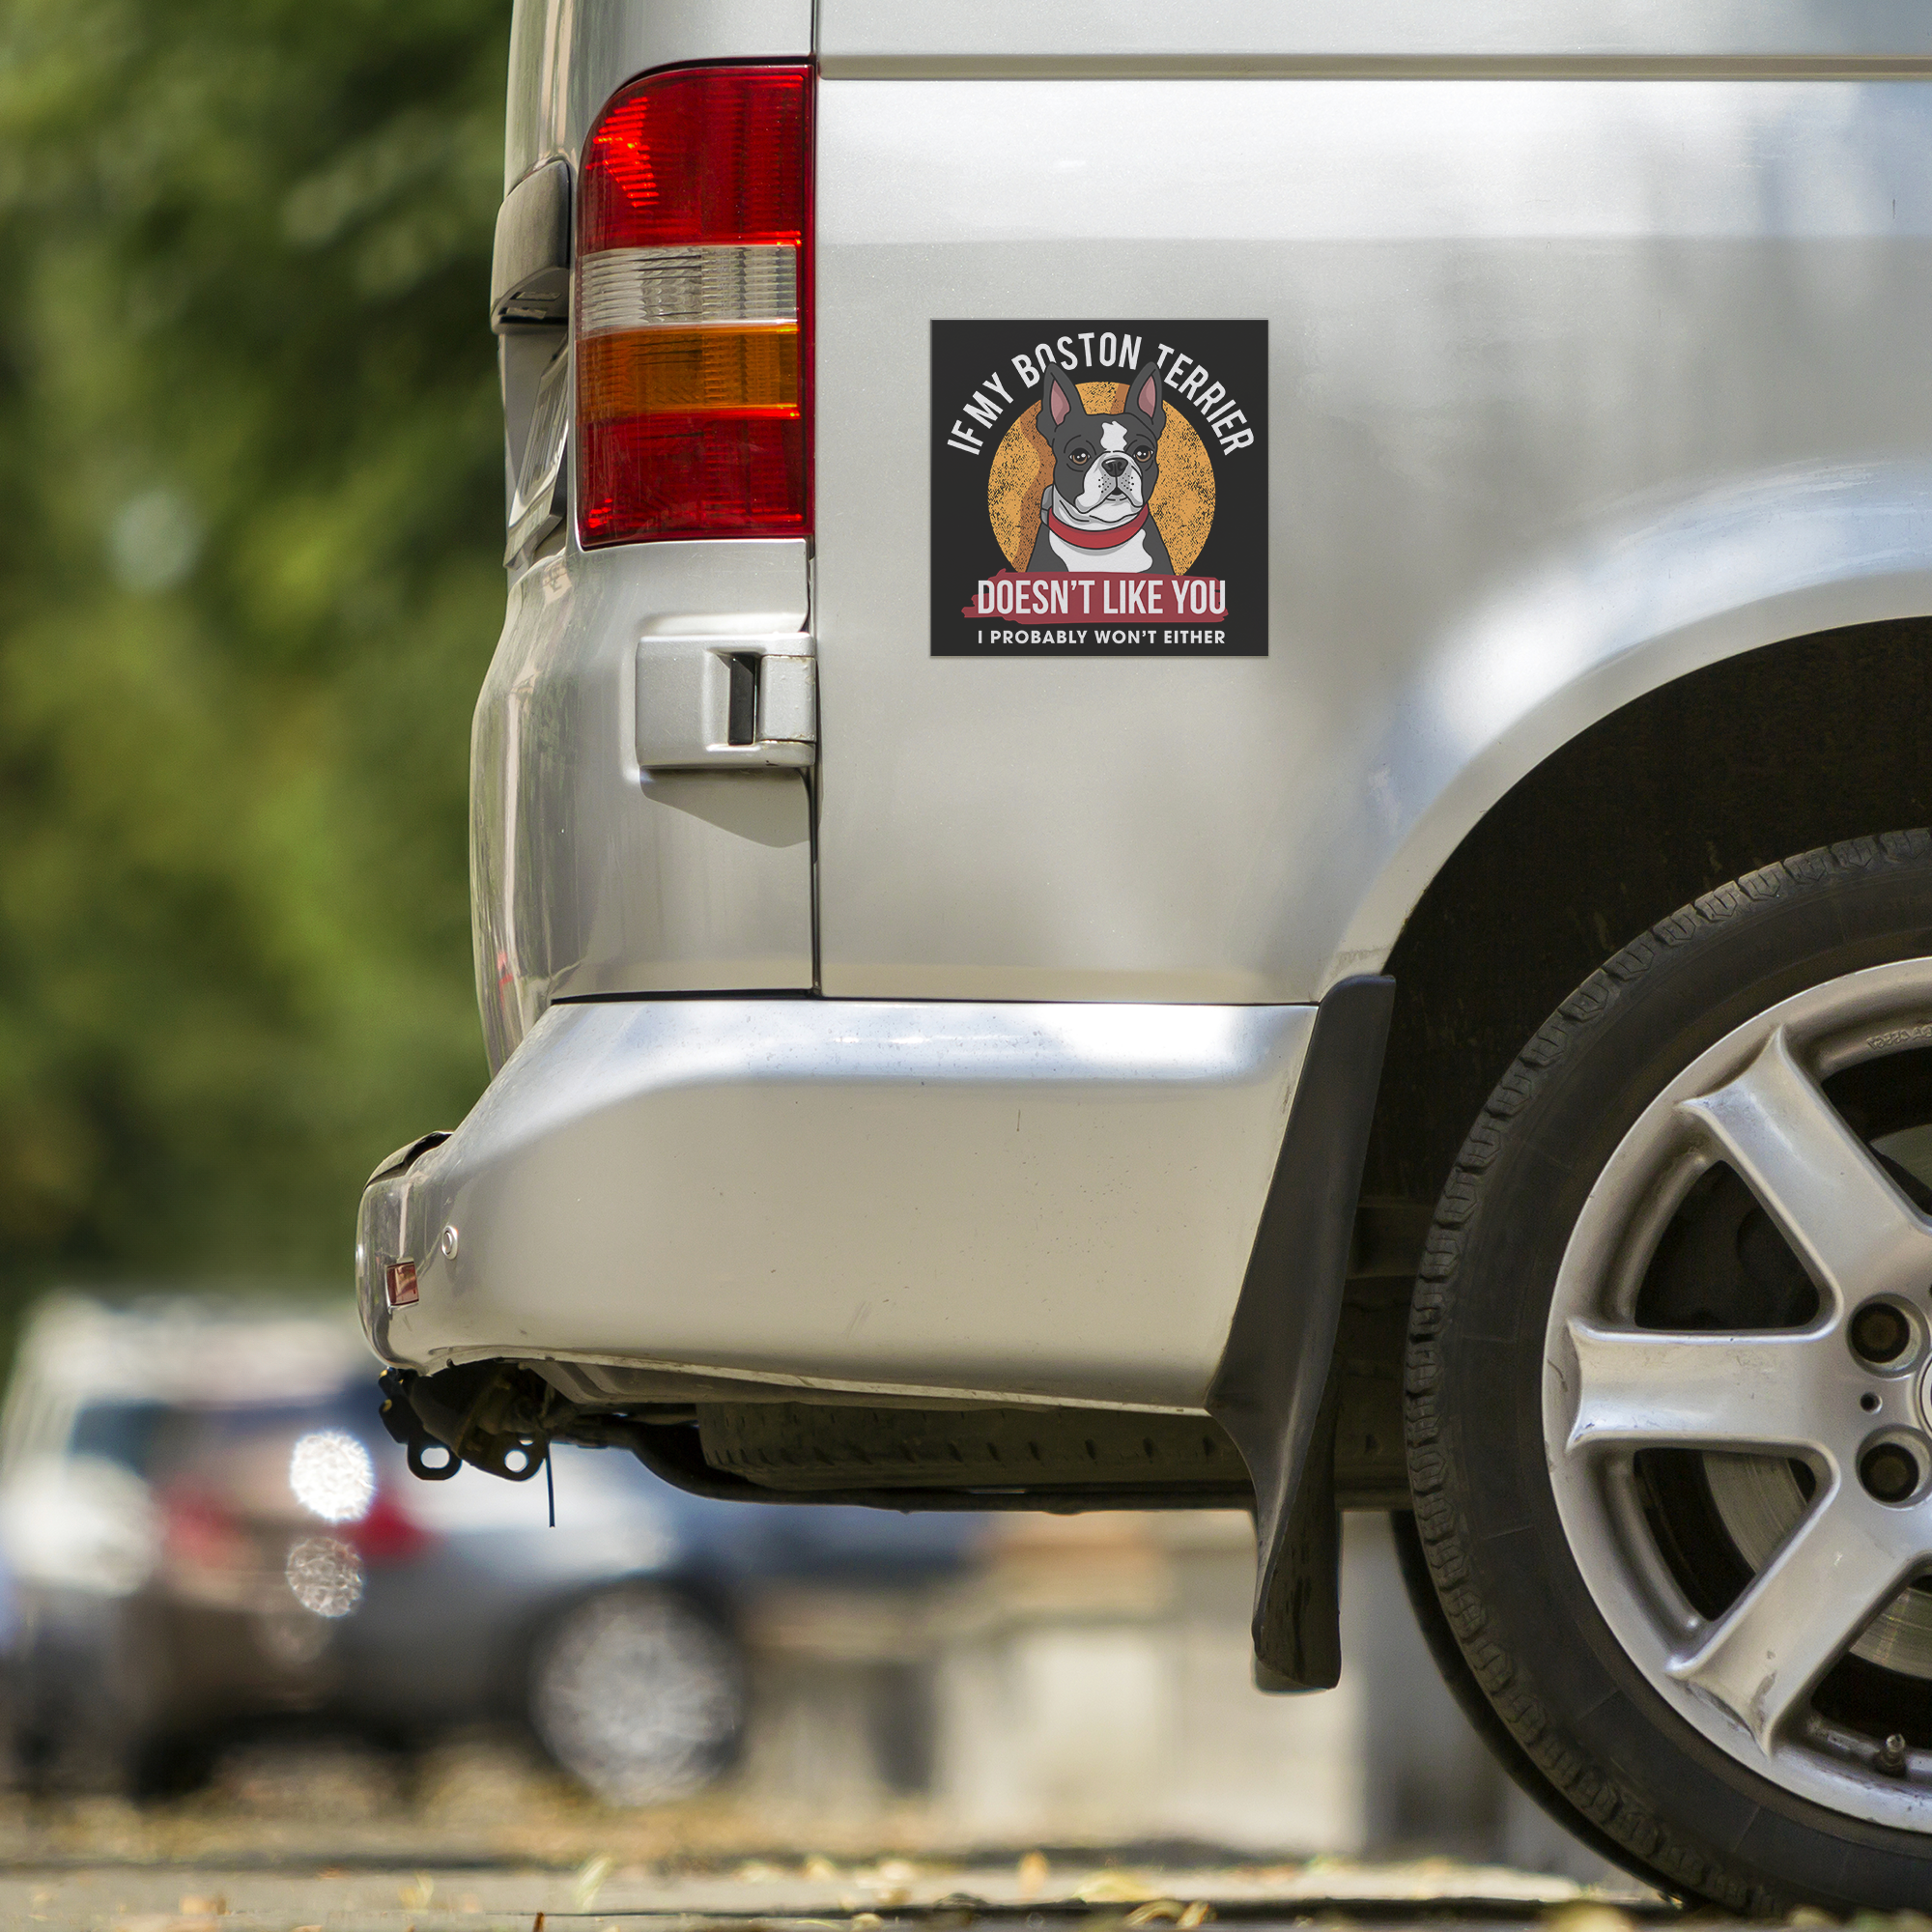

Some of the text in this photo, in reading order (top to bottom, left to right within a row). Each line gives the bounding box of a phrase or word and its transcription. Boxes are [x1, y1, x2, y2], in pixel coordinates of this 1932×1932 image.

[947, 331, 1255, 456] IF MY BOSTON TERRIER
[978, 580, 1226, 614] DOESN’T LIKE YOU
[978, 630, 1226, 644] I PROBABLY WON’T EITHER
